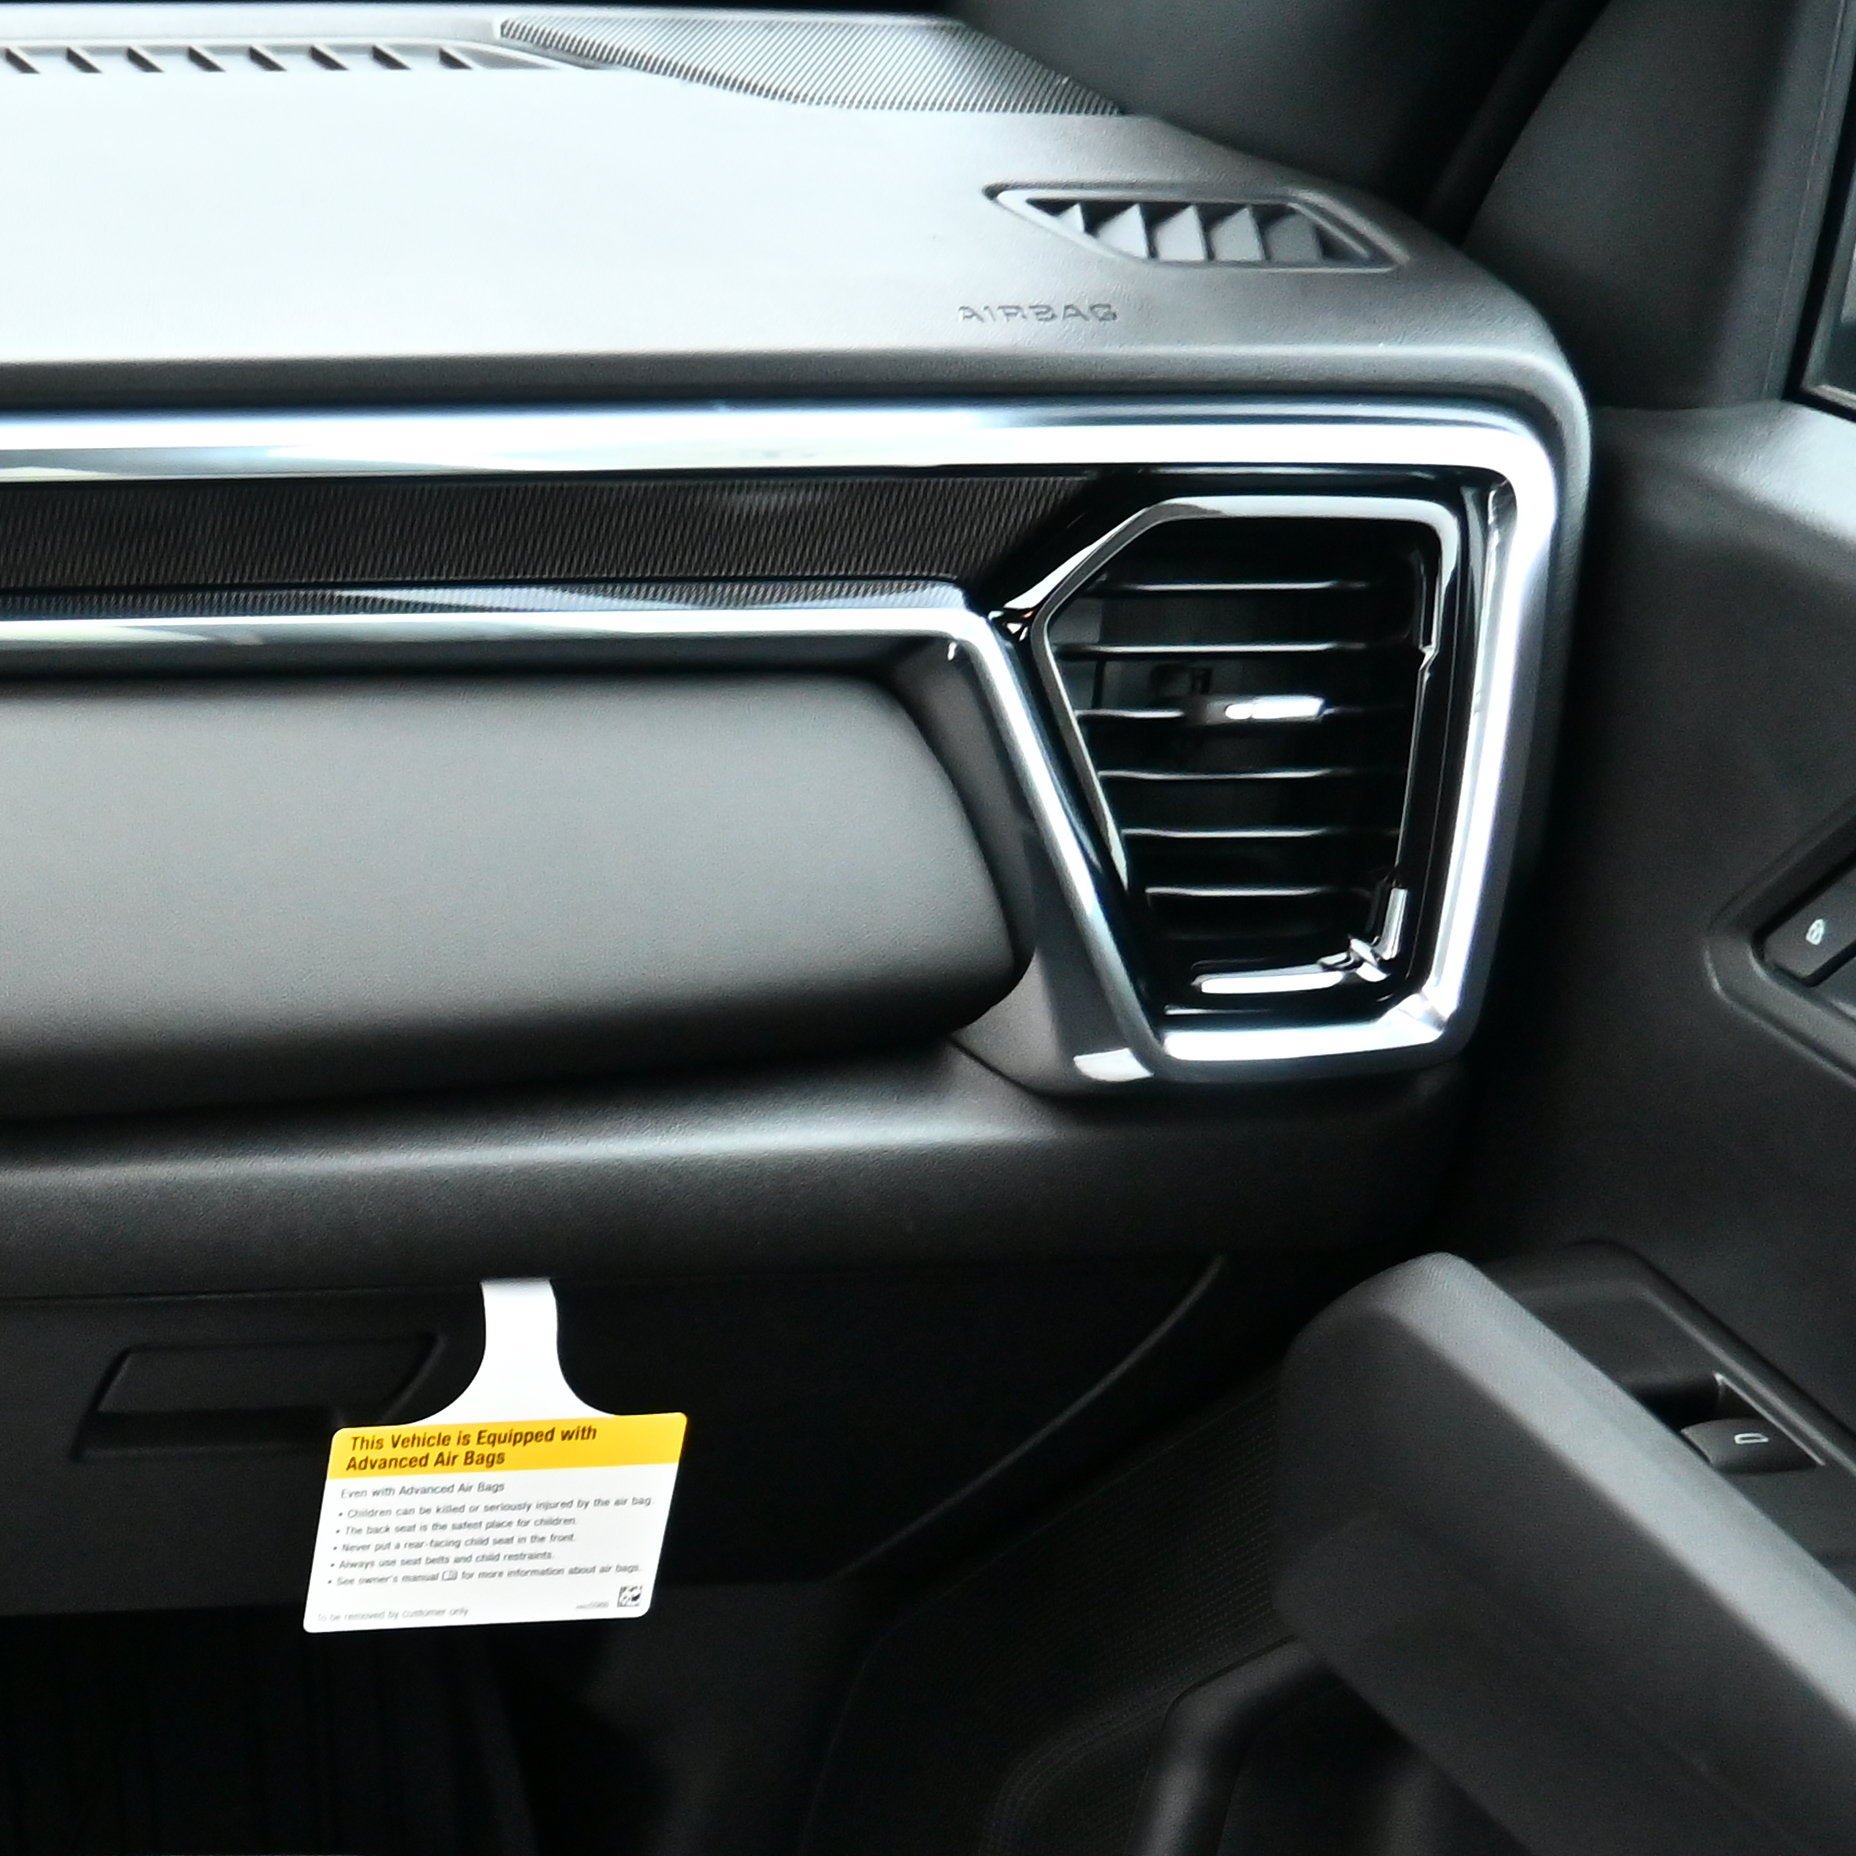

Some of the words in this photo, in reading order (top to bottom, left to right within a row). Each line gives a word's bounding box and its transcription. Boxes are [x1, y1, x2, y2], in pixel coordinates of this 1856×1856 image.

[958, 303, 1118, 323] AIRBAG
[351, 1436, 384, 1451] This
[391, 1432, 451, 1450] Vehicle
[457, 1430, 471, 1445] is
[476, 1427, 556, 1447] Equipped
[561, 1425, 597, 1441] with
[346, 1453, 429, 1471] Advanced
[434, 1452, 459, 1467] Air
[463, 1451, 505, 1468] Bags
[340, 1488, 368, 1499] Even
[372, 1486, 395, 1497] with
[398, 1483, 455, 1496] Advanced
[457, 1482, 473, 1493] Air
[477, 1481, 505, 1493] Bags
[396, 1508, 415, 1516] can
[419, 1505, 432, 1515] be
[576, 1499, 590, 1509] by
[593, 1498, 610, 1507] the
